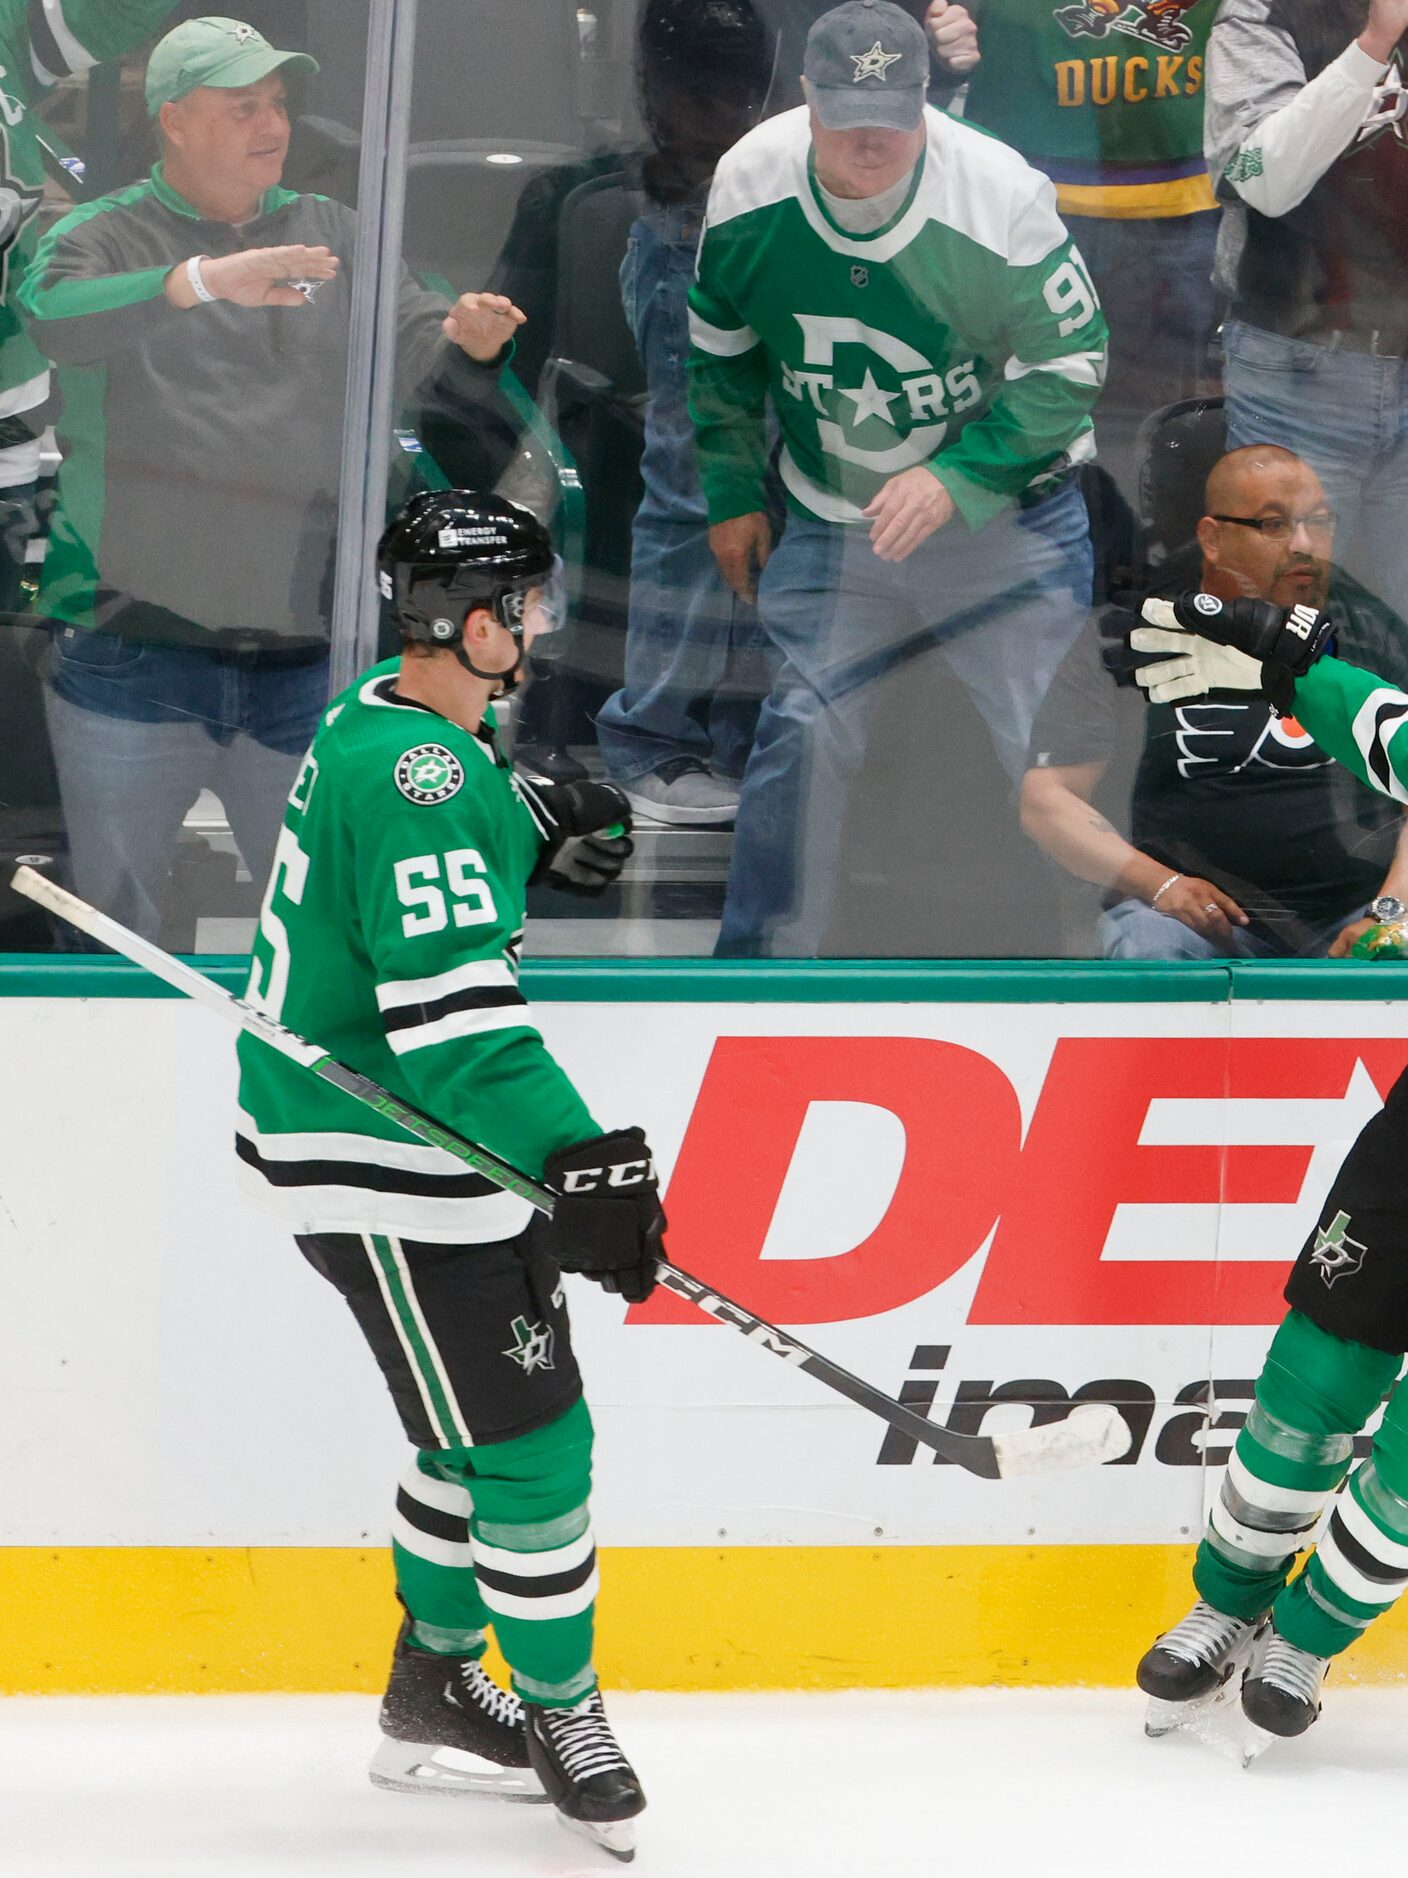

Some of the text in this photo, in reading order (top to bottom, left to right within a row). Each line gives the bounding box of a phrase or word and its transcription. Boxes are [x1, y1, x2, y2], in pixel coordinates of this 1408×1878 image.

[1055, 55, 1203, 107] DUCKS
[457, 526, 498, 536] ENERGY
[457, 535, 508, 546] TRANSFER
[393, 848, 498, 938] 55
[363, 1093, 536, 1199] JETSPEED
[655, 1264, 815, 1367] CCM
